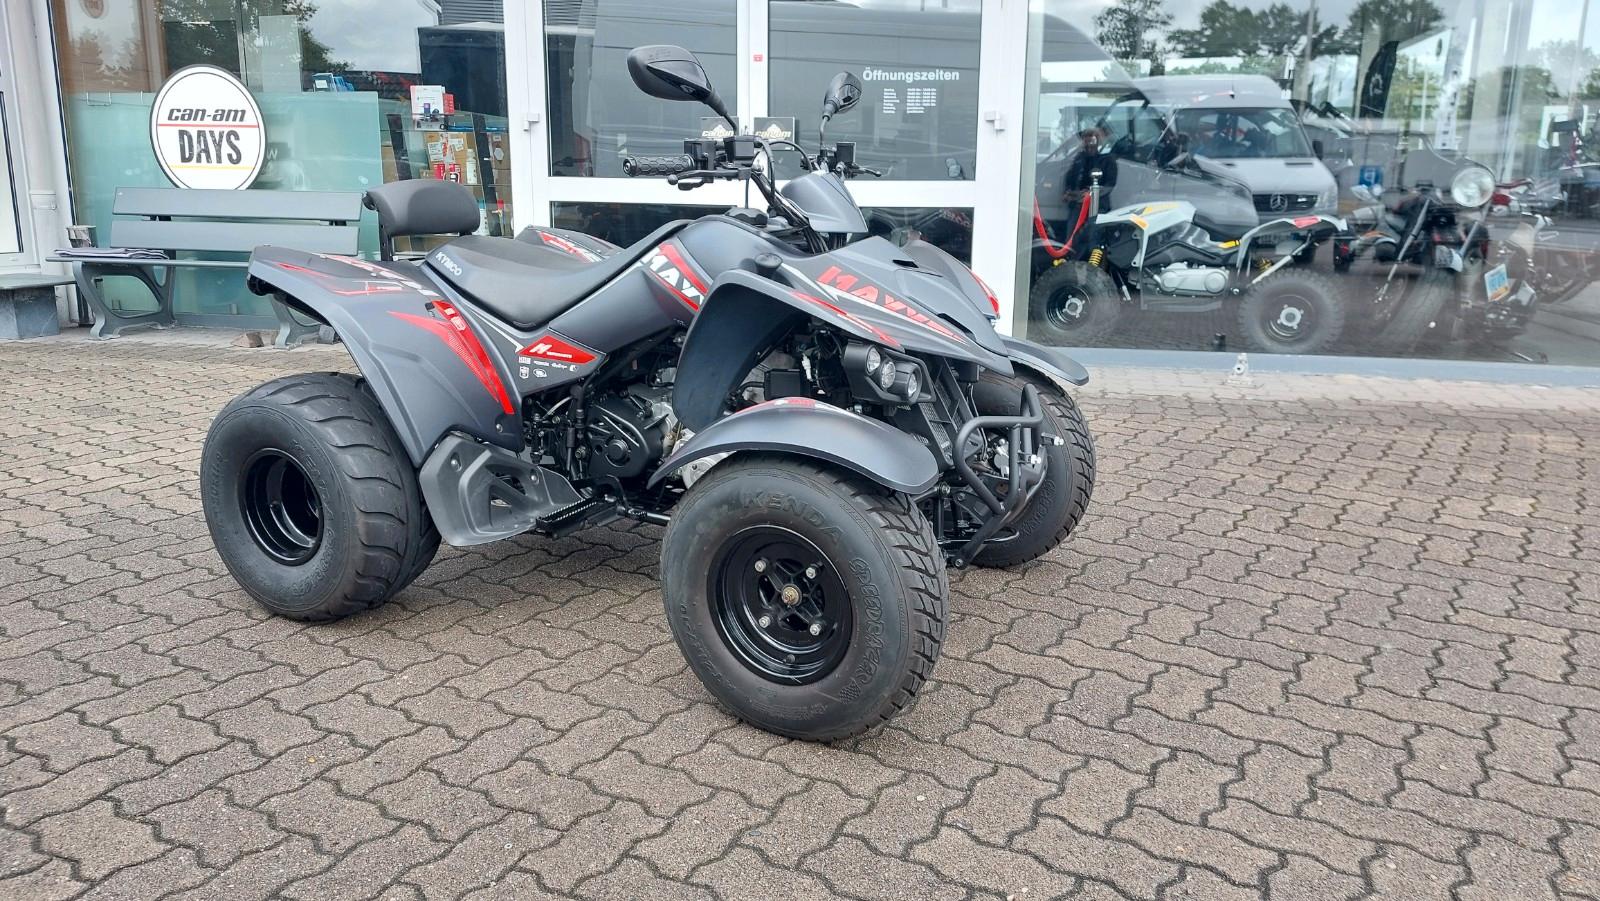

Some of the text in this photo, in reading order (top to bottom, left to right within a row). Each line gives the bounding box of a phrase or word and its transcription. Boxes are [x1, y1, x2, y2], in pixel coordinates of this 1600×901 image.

[862, 66, 960, 83] Öffnungszeiten
[167, 108, 246, 122] can-am
[178, 129, 242, 165] DAYS
[435, 251, 462, 276] KYMCO
[746, 492, 845, 544] KENDA
